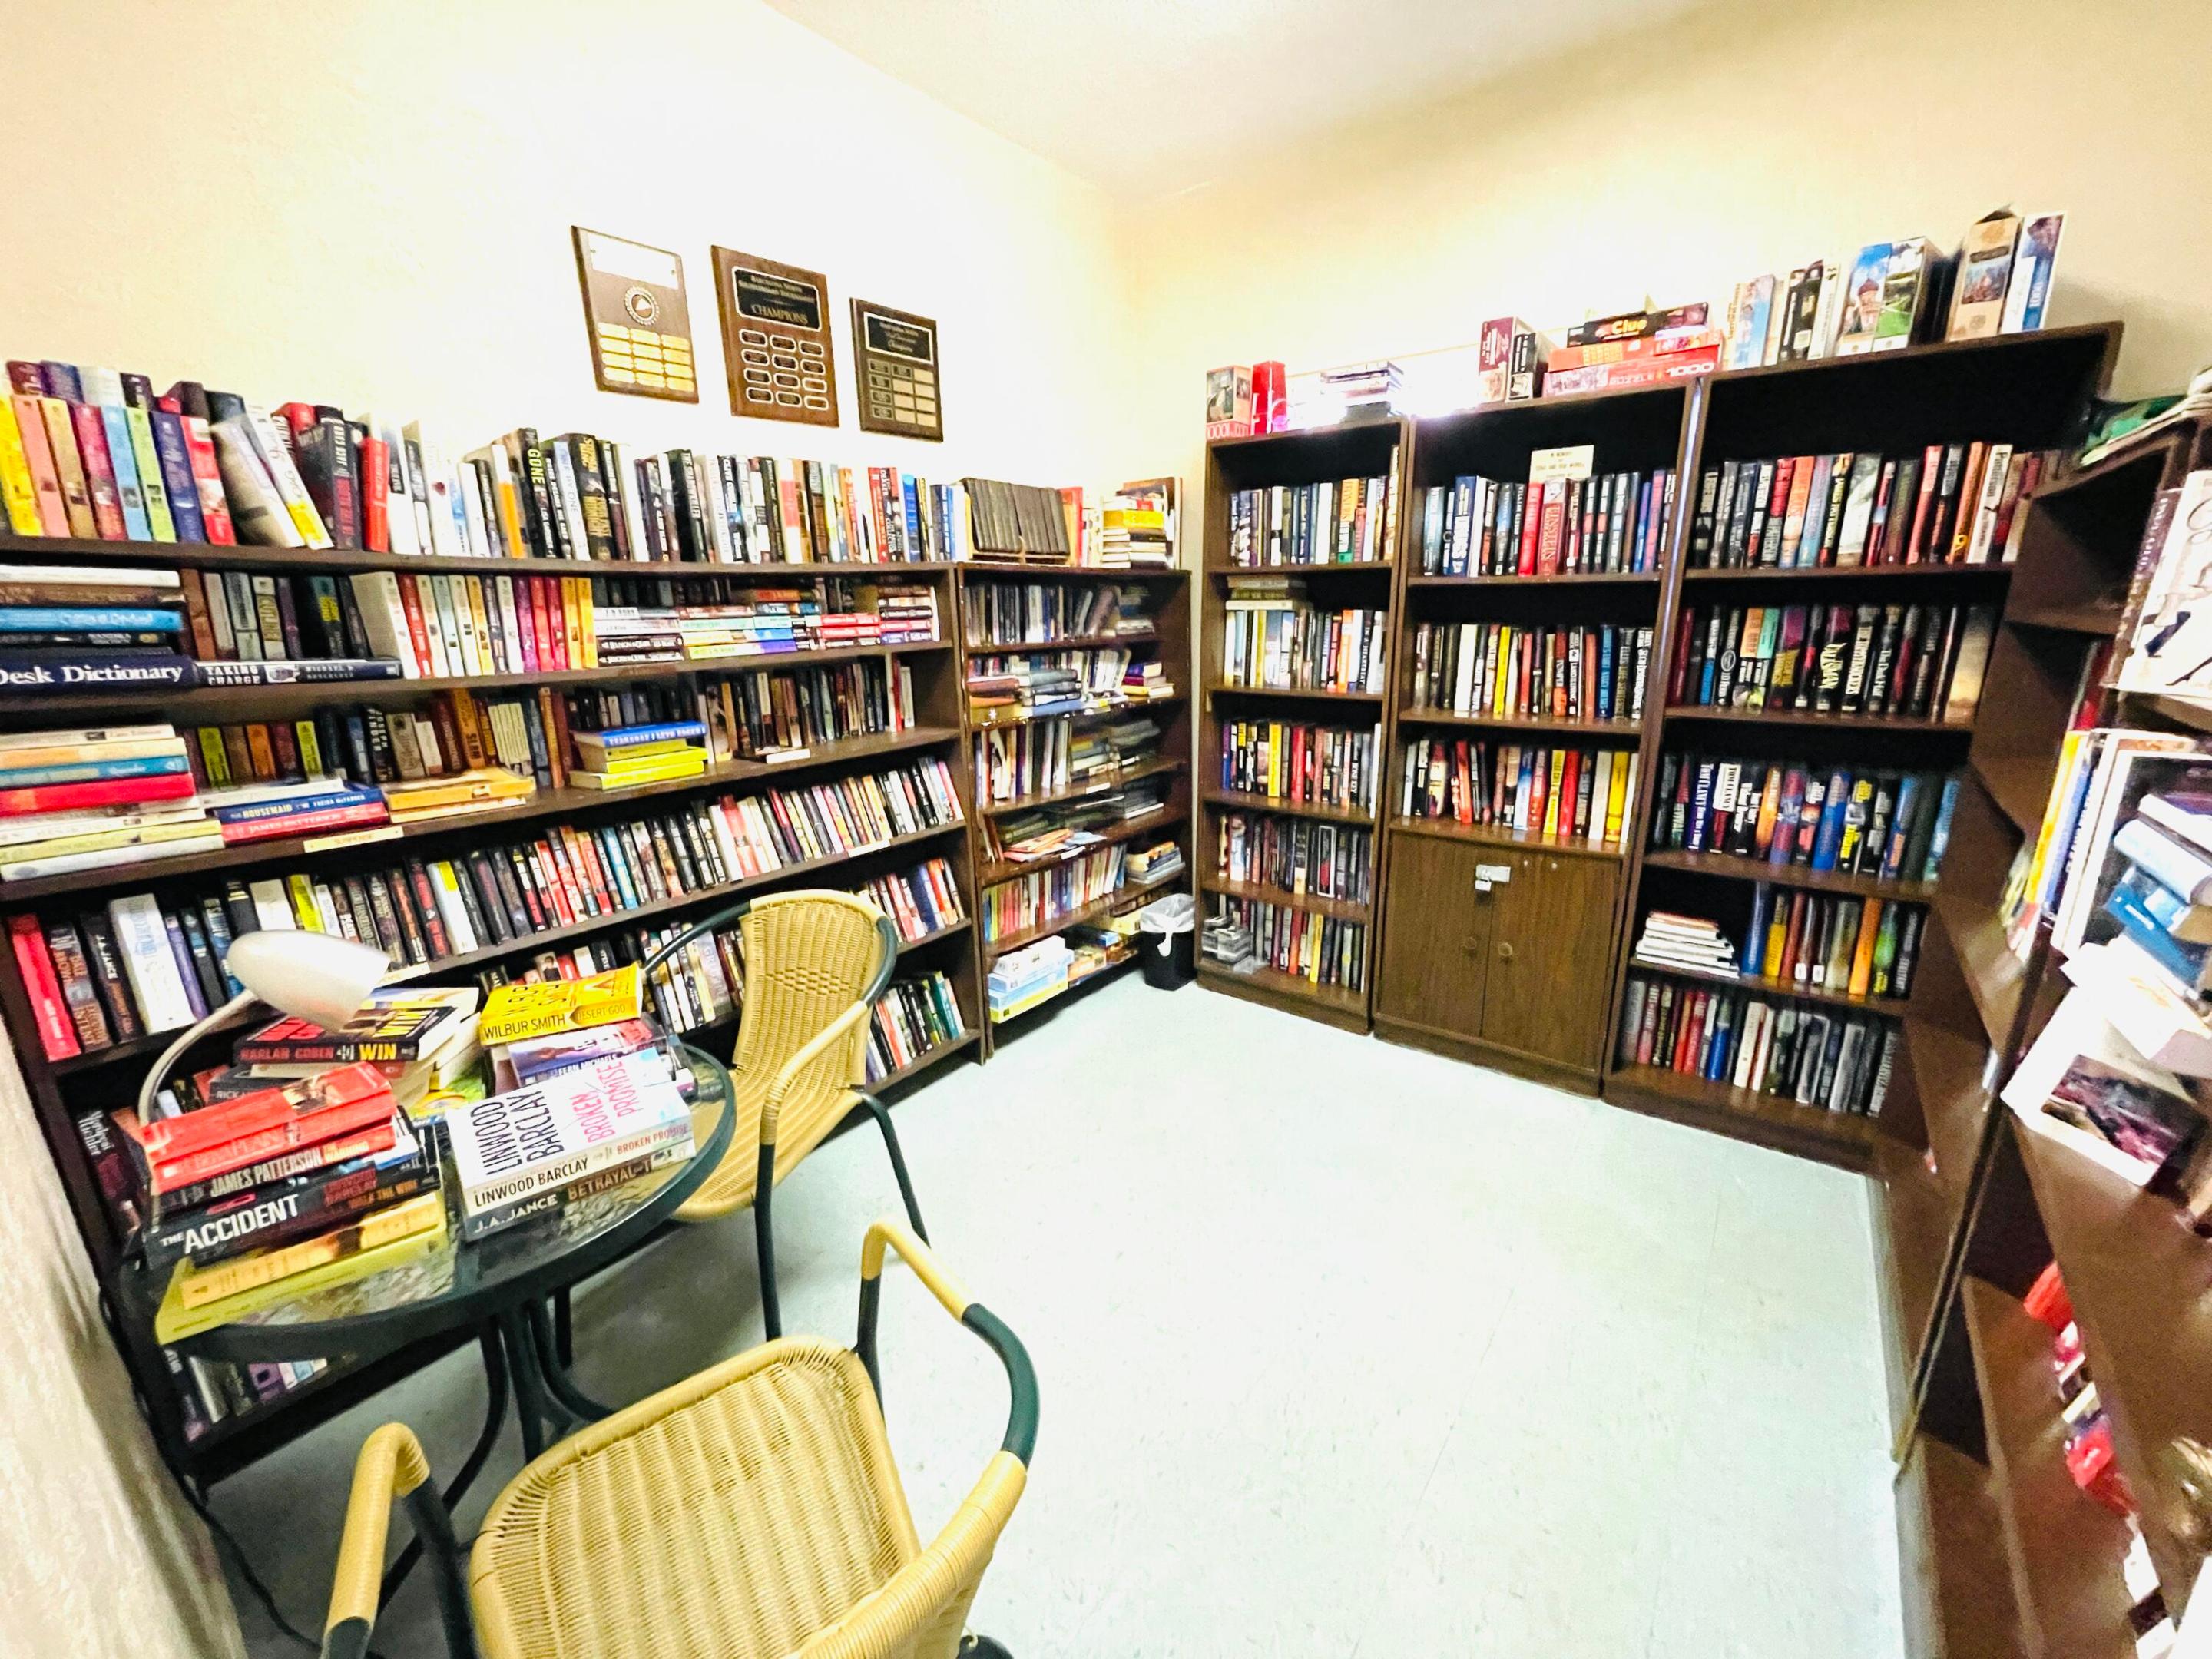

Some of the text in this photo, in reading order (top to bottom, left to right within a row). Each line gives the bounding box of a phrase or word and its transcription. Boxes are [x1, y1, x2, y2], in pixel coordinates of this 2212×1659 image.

[750, 304, 809, 325] CHAMPIONS
[1611, 318, 1648, 335] Clue
[1666, 362, 1716, 378] 1000
[526, 447, 546, 486] GONE
[578, 442, 591, 468] KING
[568, 492, 578, 513] ONE
[61, 664, 184, 683] Dictionary
[204, 665, 259, 676] TAKING
[1359, 645, 1368, 684] HEARTBEAT
[207, 676, 262, 686] CHARGE
[367, 708, 382, 752] FINDER
[1696, 779, 1710, 806] CLANCY
[243, 803, 293, 819] HOUSEMAID
[248, 821, 283, 833] JAMES
[53, 948, 76, 986] BROWN
[101, 949, 118, 980] JANCE
[576, 1003, 627, 1022] DESERT GOD
[484, 1013, 566, 1040] WILBUR SMITH
[240, 1044, 335, 1061] HARLAN COBEN
[358, 1042, 398, 1061] WIN
[596, 1061, 639, 1118] PROMISE
[506, 1089, 565, 1162] BARCLAY
[569, 1090, 616, 1144] BROKEN
[469, 1101, 523, 1175] LINWOOD
[616, 1121, 689, 1156] BROKEN PROMISE
[210, 1170, 254, 1197] JAMES
[253, 1147, 323, 1187] PATTERSON
[474, 1157, 590, 1208] LINWOOD BARCLAY
[567, 1164, 637, 1202] BETRAYAL
[508, 1194, 559, 1220] JANCE
[160, 1194, 300, 1254] THE ACCIDENT
